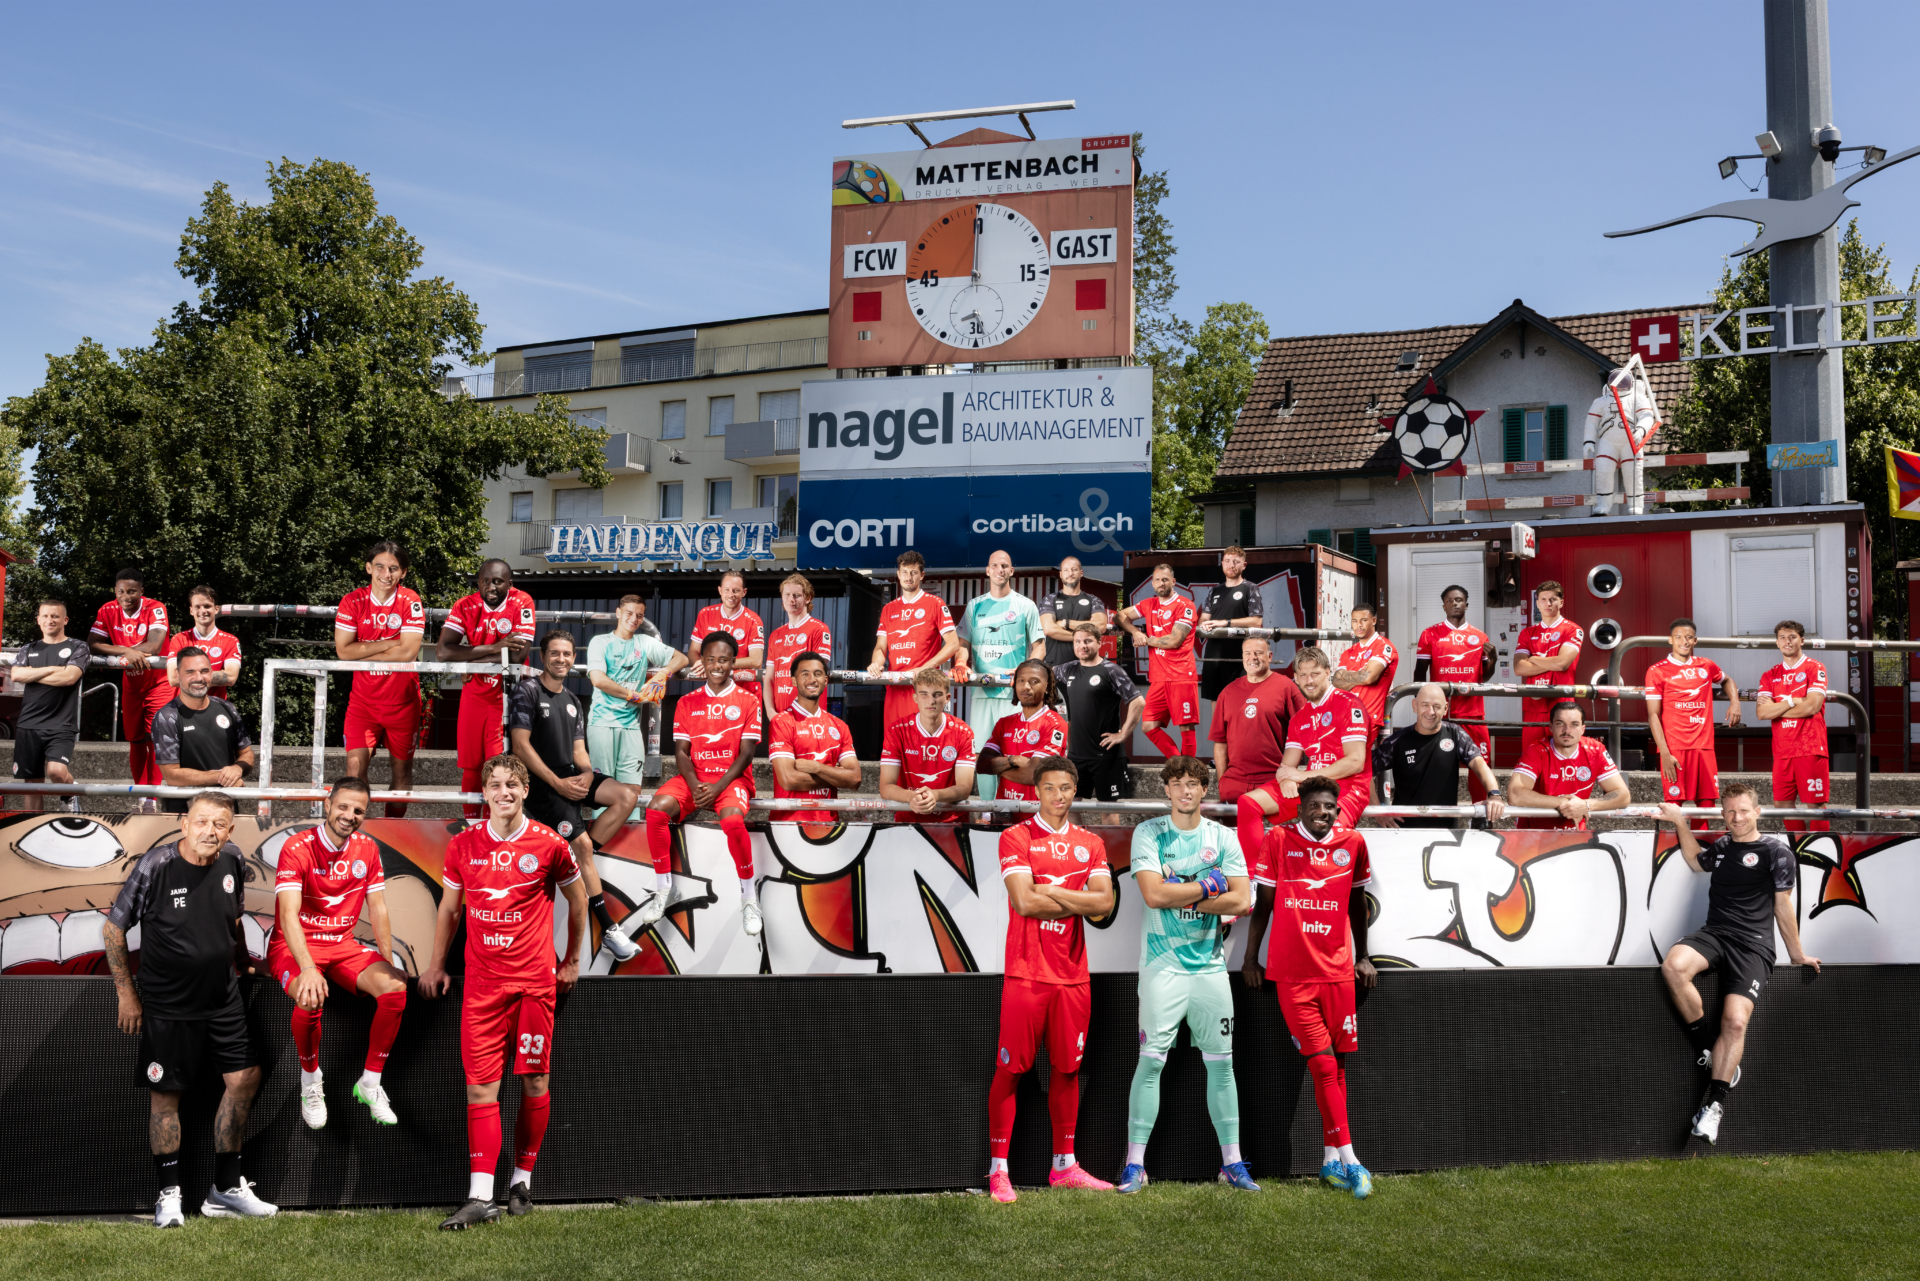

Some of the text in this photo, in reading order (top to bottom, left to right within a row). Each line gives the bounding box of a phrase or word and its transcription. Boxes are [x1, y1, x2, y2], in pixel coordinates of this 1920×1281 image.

[1085, 138, 1127, 148] GRUPPE
[915, 153, 1099, 186] MATTENBACH
[915, 188, 962, 199] DRUCK
[987, 181, 1043, 193] VERLAG
[1070, 178, 1099, 187] WEB
[1056, 234, 1112, 259] GAST
[854, 248, 897, 272] FCW
[919, 269, 939, 288] 45
[1020, 264, 1036, 282] 15
[969, 321, 984, 335] 30
[1694, 291, 1920, 359] KELLE
[962, 386, 1115, 412] ARCHITEKTUR &
[807, 391, 954, 461] nagel
[962, 417, 1145, 443] BAUMANAGEMENT
[1779, 446, 1832, 469] Prosecco
[972, 512, 1134, 534] cortibau.ch
[545, 521, 780, 563] HALDENGUT
[809, 518, 915, 548] CORTI
[893, 642, 916, 650] KELLER
[984, 650, 1003, 659] Init7
[1782, 720, 1797, 728] Init7
[734, 787, 748, 803] 19
[170, 887, 188, 896] JAKO
[173, 896, 186, 908] PE
[1295, 899, 1338, 911] KELLER
[475, 909, 522, 922] KELLER
[1040, 919, 1066, 934] nit7
[1303, 920, 1332, 935] Init7
[483, 933, 514, 948] Init7
[519, 1033, 545, 1055] 33
